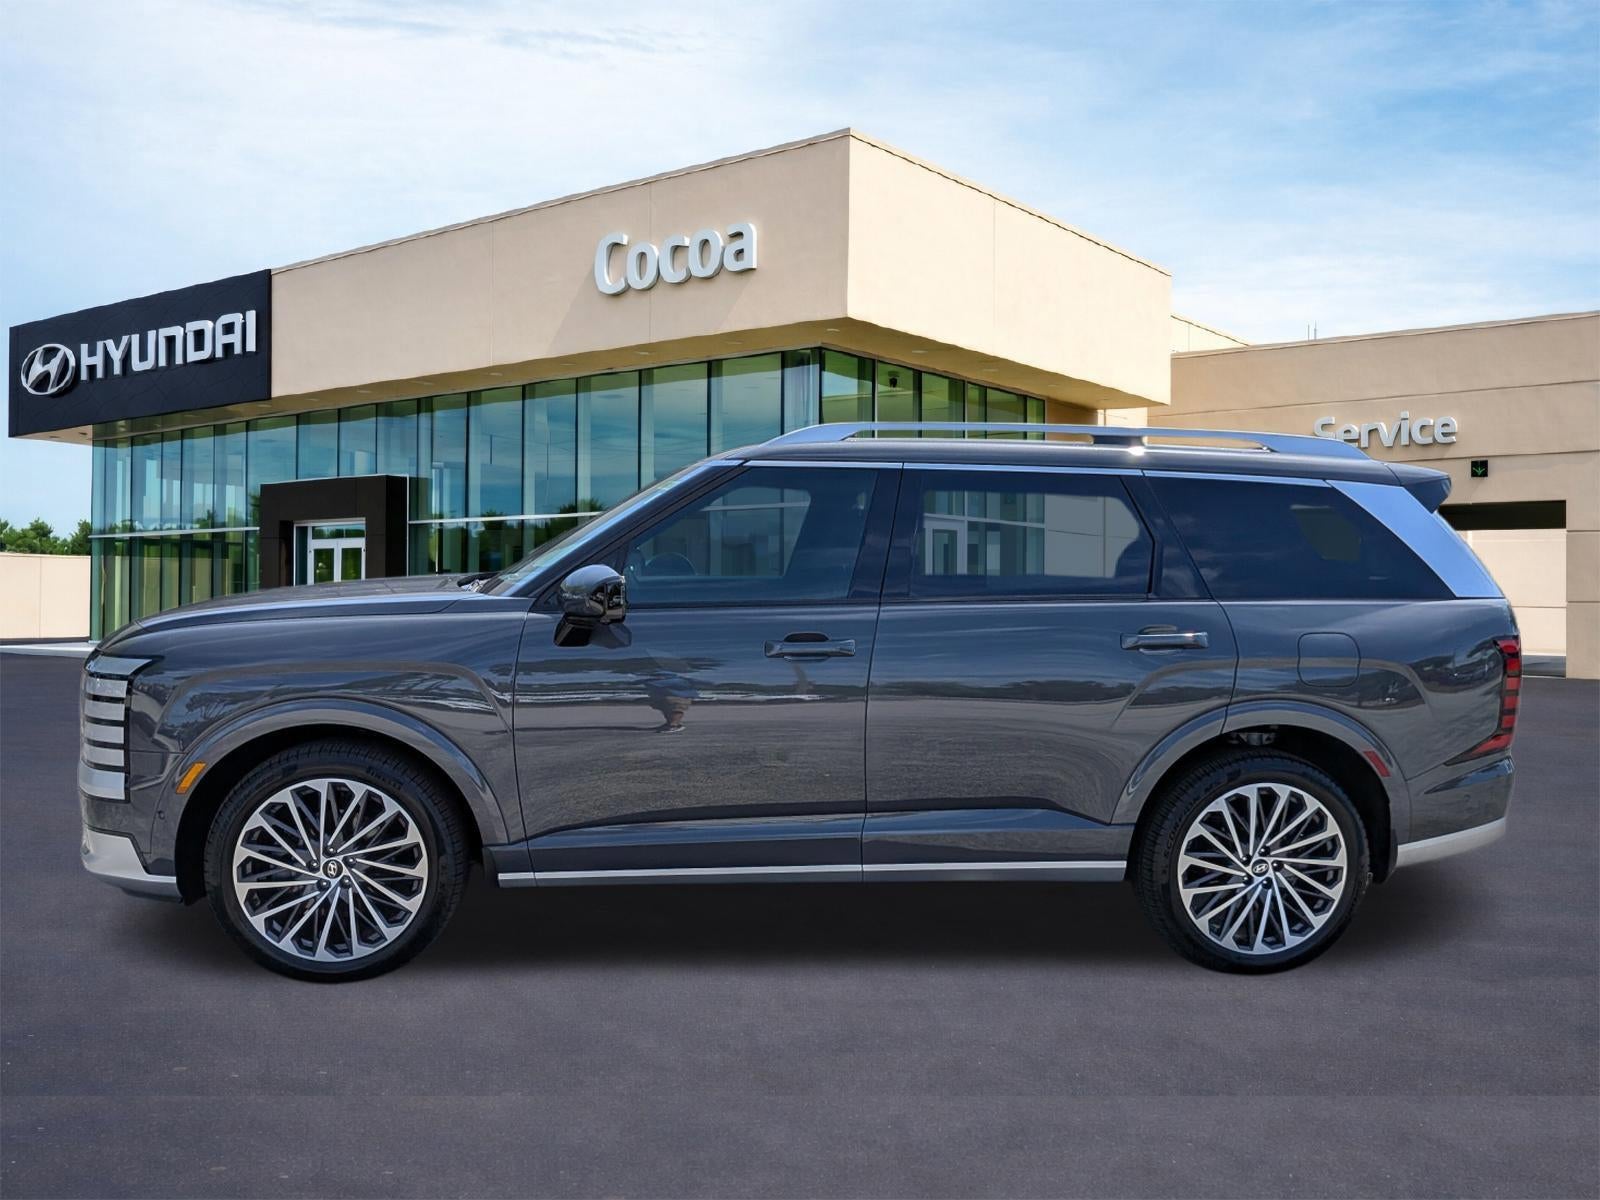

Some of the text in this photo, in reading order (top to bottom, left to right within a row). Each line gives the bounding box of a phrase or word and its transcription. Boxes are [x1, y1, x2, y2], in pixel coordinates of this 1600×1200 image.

[594, 222, 758, 296] Cocoa
[80, 309, 257, 381] HYUNDAI
[1313, 410, 1458, 449] Service
